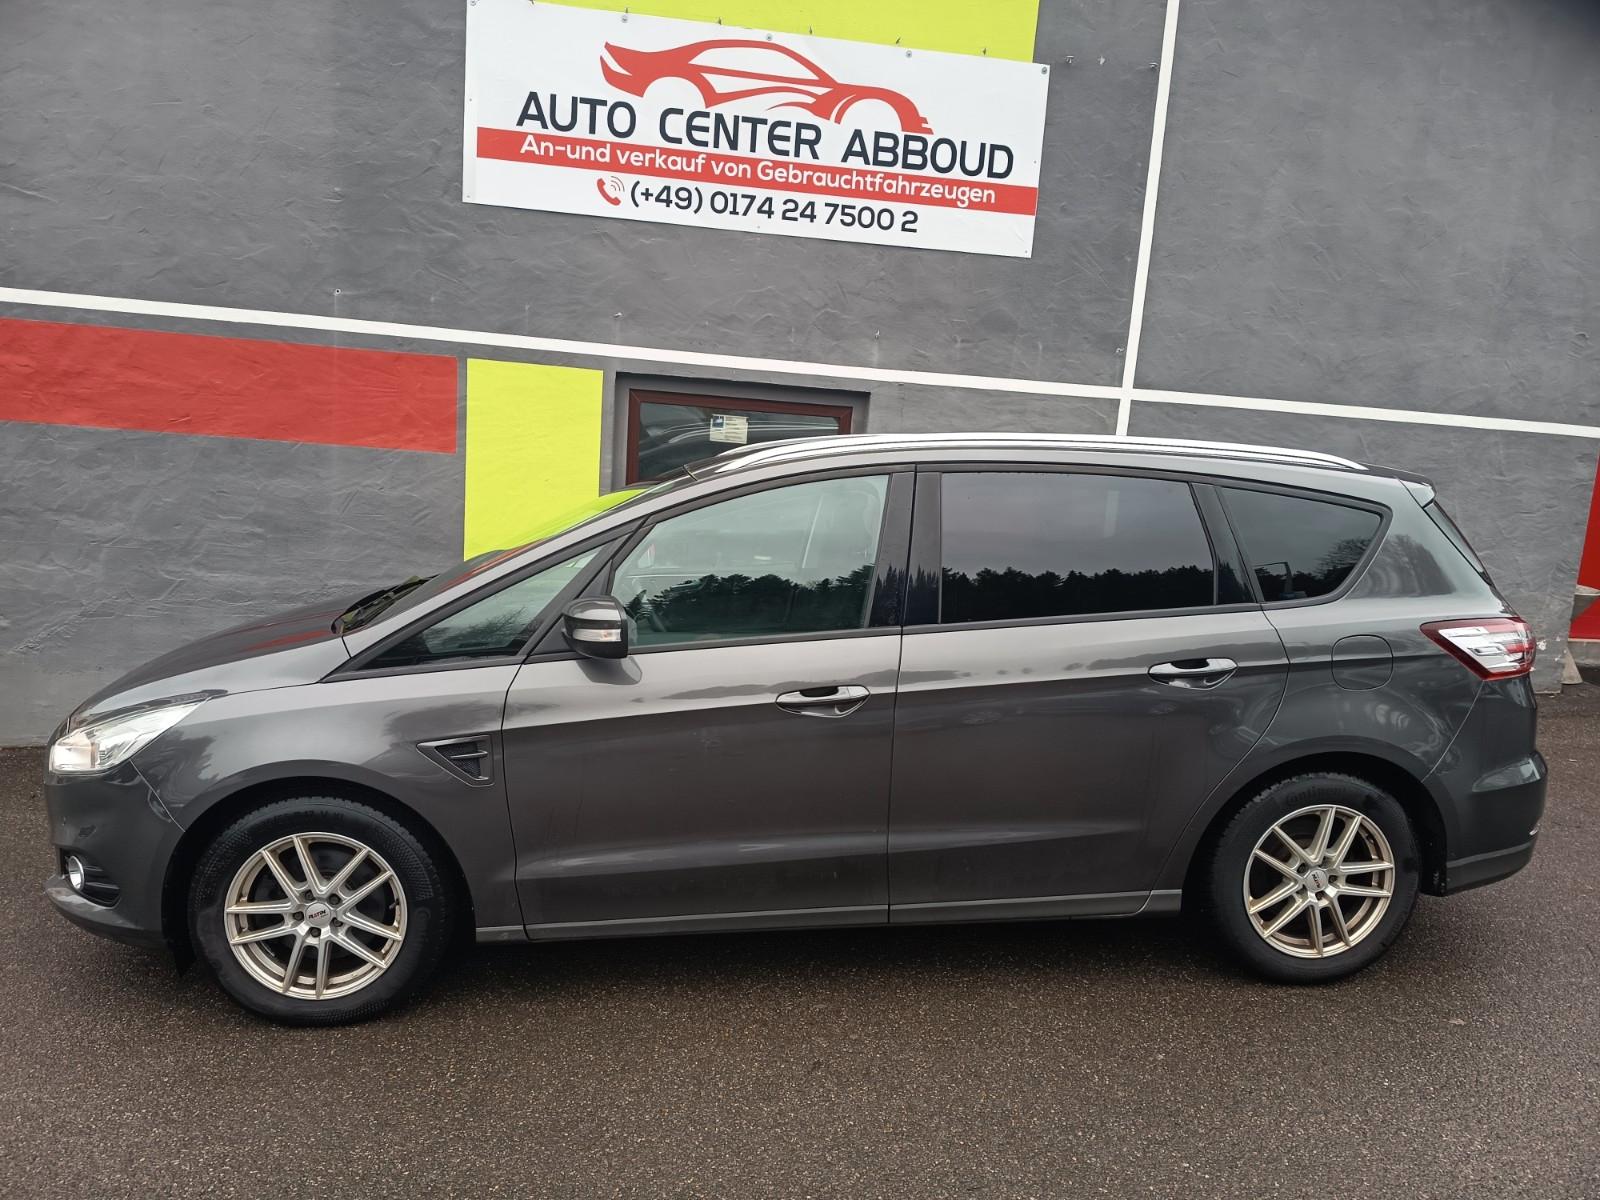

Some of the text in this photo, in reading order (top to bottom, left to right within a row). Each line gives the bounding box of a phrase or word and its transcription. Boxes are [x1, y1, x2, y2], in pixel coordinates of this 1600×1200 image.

[516, 91, 1014, 179] AUTO CENTER ABBOUD
[519, 134, 996, 208] An-und verkauf von Gebrauchtfahrzeugen
[630, 180, 919, 233] (+49) 0174 24 7500 2
